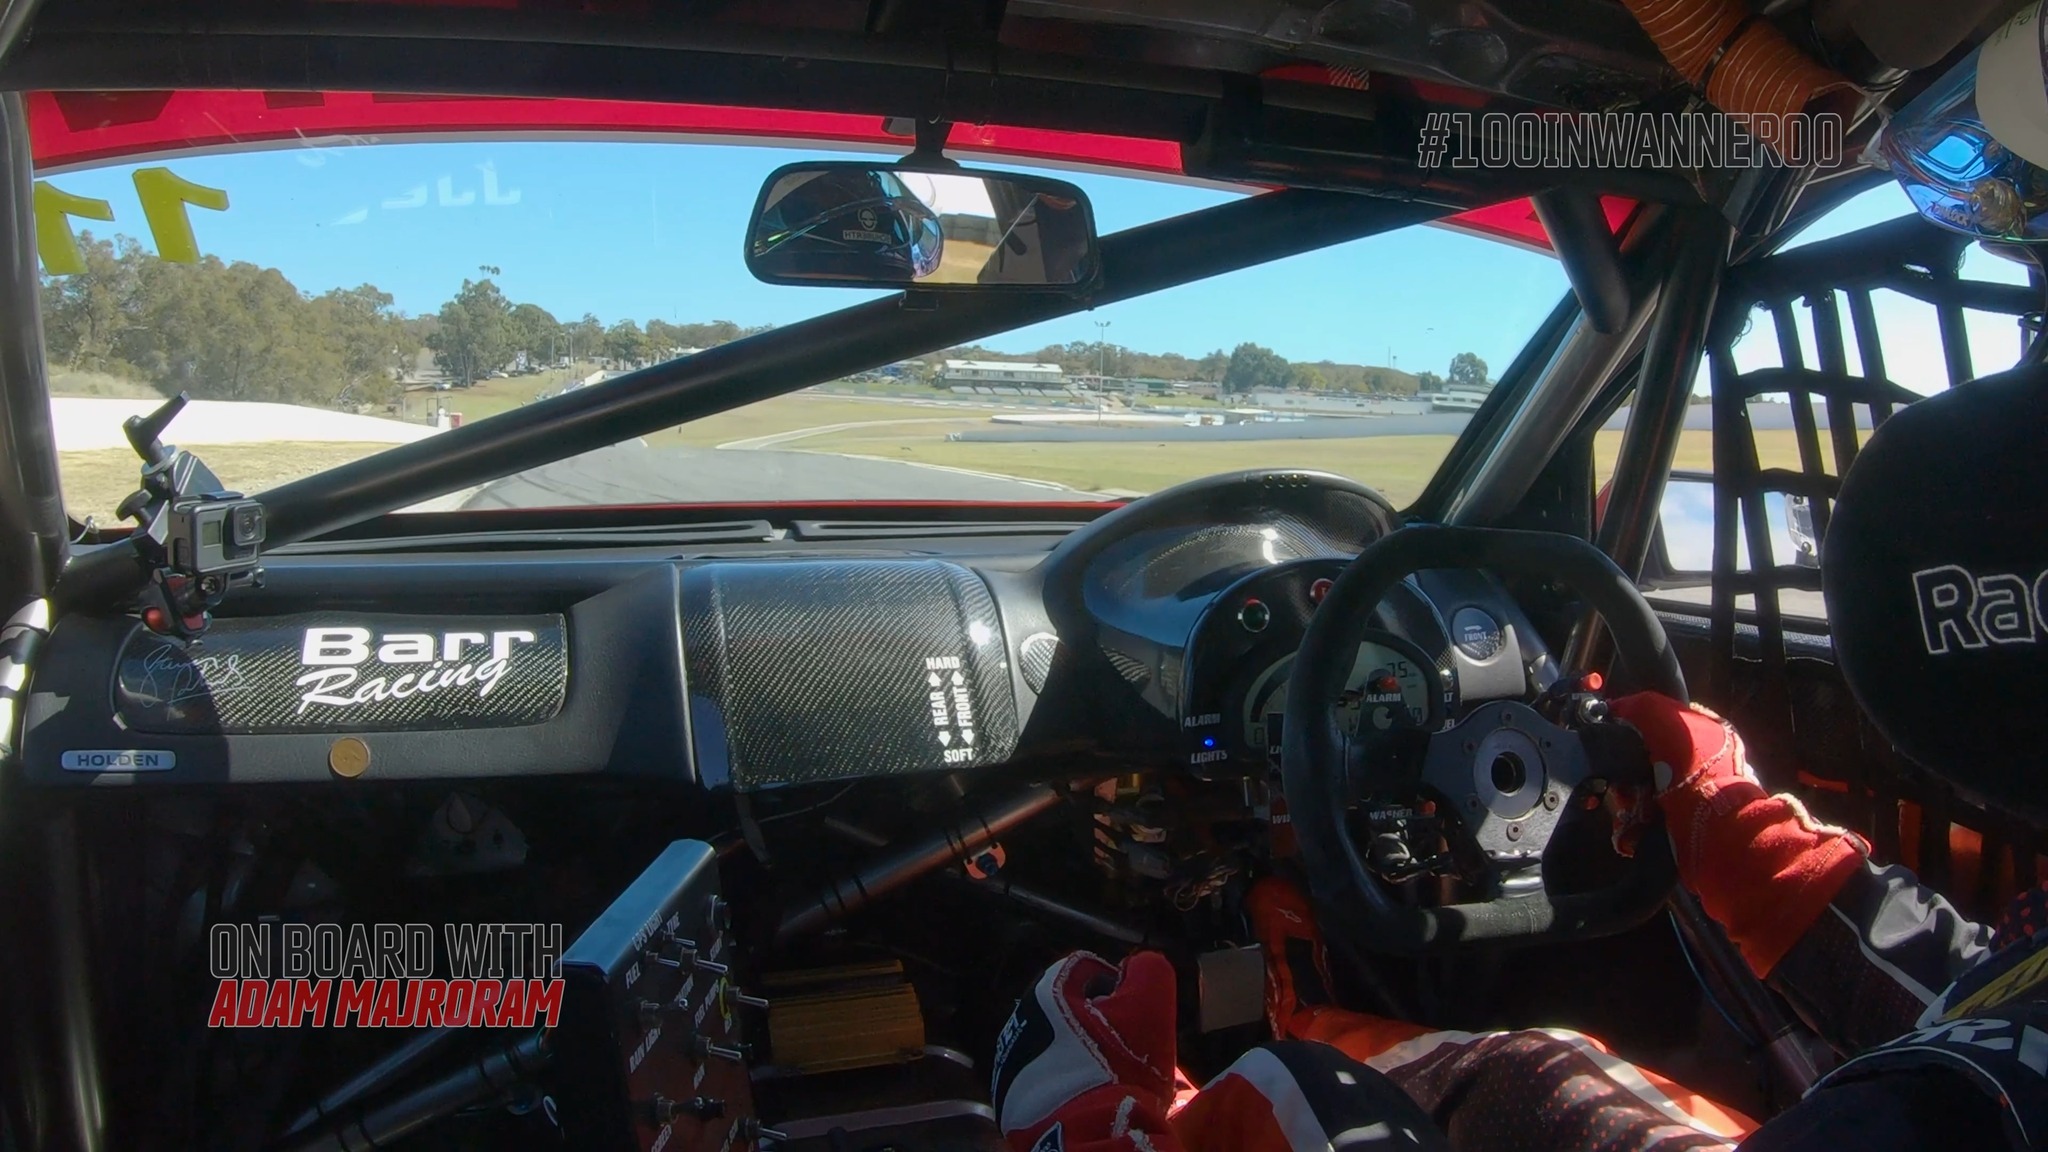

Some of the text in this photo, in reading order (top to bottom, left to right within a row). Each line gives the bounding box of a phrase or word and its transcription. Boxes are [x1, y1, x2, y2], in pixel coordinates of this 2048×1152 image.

[1464, 630, 1487, 642] FRONT
[300, 626, 538, 666] Barr
[926, 656, 961, 669] HARD
[295, 656, 513, 715] Racing
[1366, 692, 1402, 703] ALARM
[930, 690, 949, 726] REAR
[954, 686, 973, 727] FRONT
[1184, 712, 1222, 728] ALARM
[76, 752, 161, 768] HOLDEN
[943, 748, 974, 763] SOFT
[1190, 749, 1228, 764] LIGHTS
[625, 961, 641, 989] FUEL
